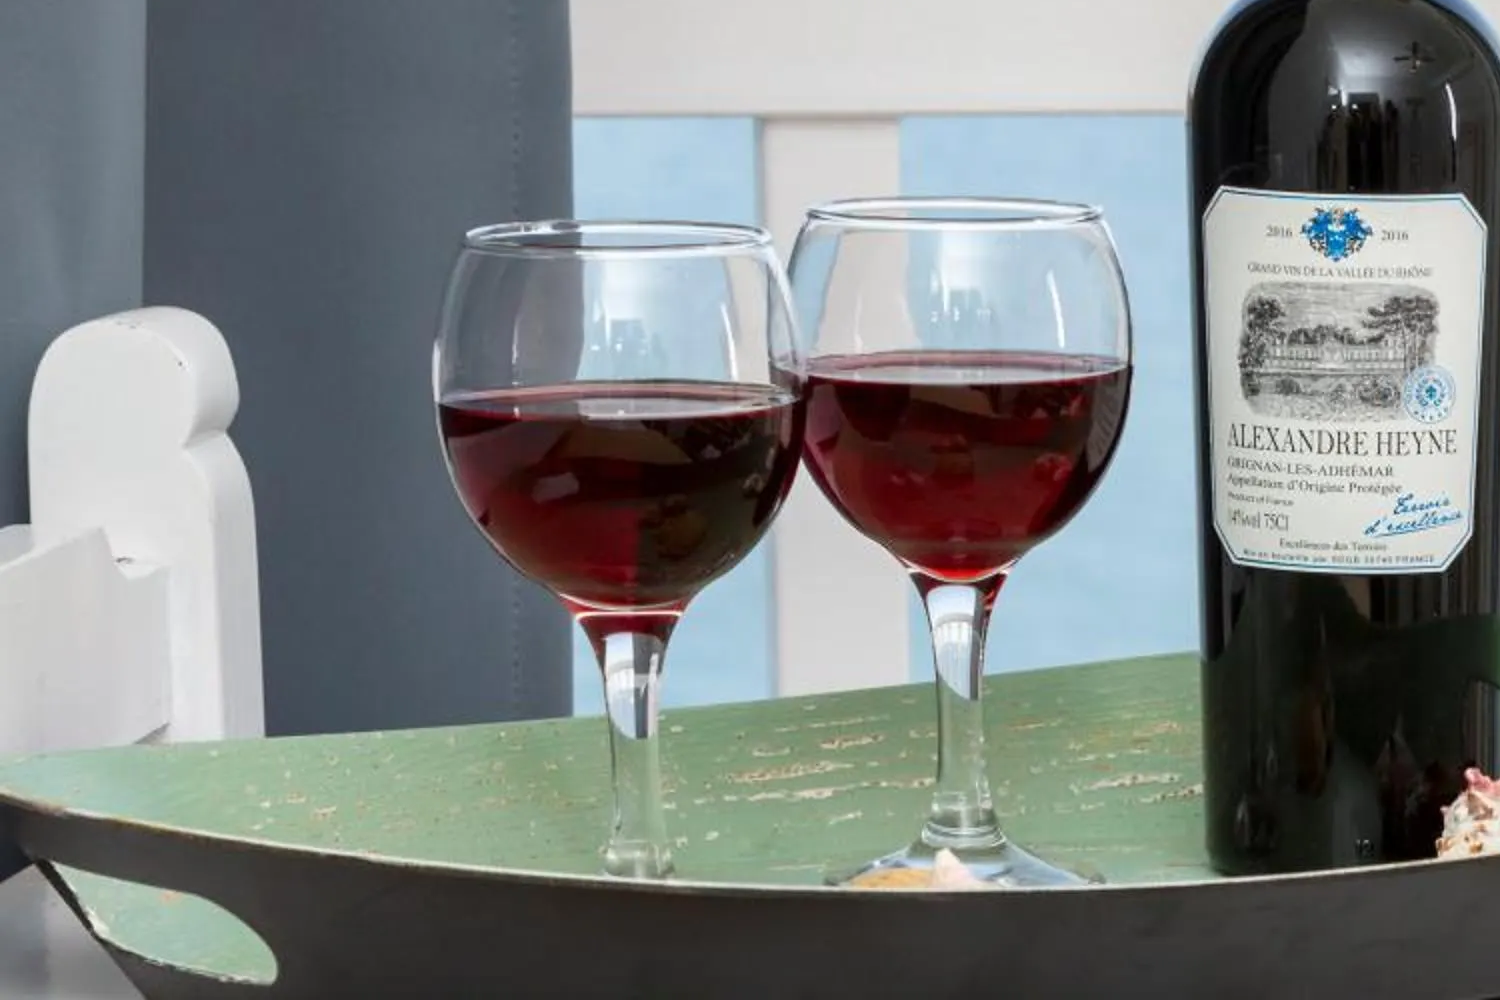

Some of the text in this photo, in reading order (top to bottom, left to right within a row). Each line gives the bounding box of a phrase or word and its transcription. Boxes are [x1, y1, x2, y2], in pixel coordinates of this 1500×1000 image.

[1381, 229, 1409, 241] 2016
[1247, 262, 1281, 275] GRAND
[1283, 264, 1301, 276] VIN
[1303, 265, 1317, 277] DE
[1319, 266, 1334, 277] LA
[1227, 423, 1457, 456] ALEXANDRE HEYNE
[1227, 473, 1284, 490] Appellation
[1286, 480, 1345, 494] d'Origine
